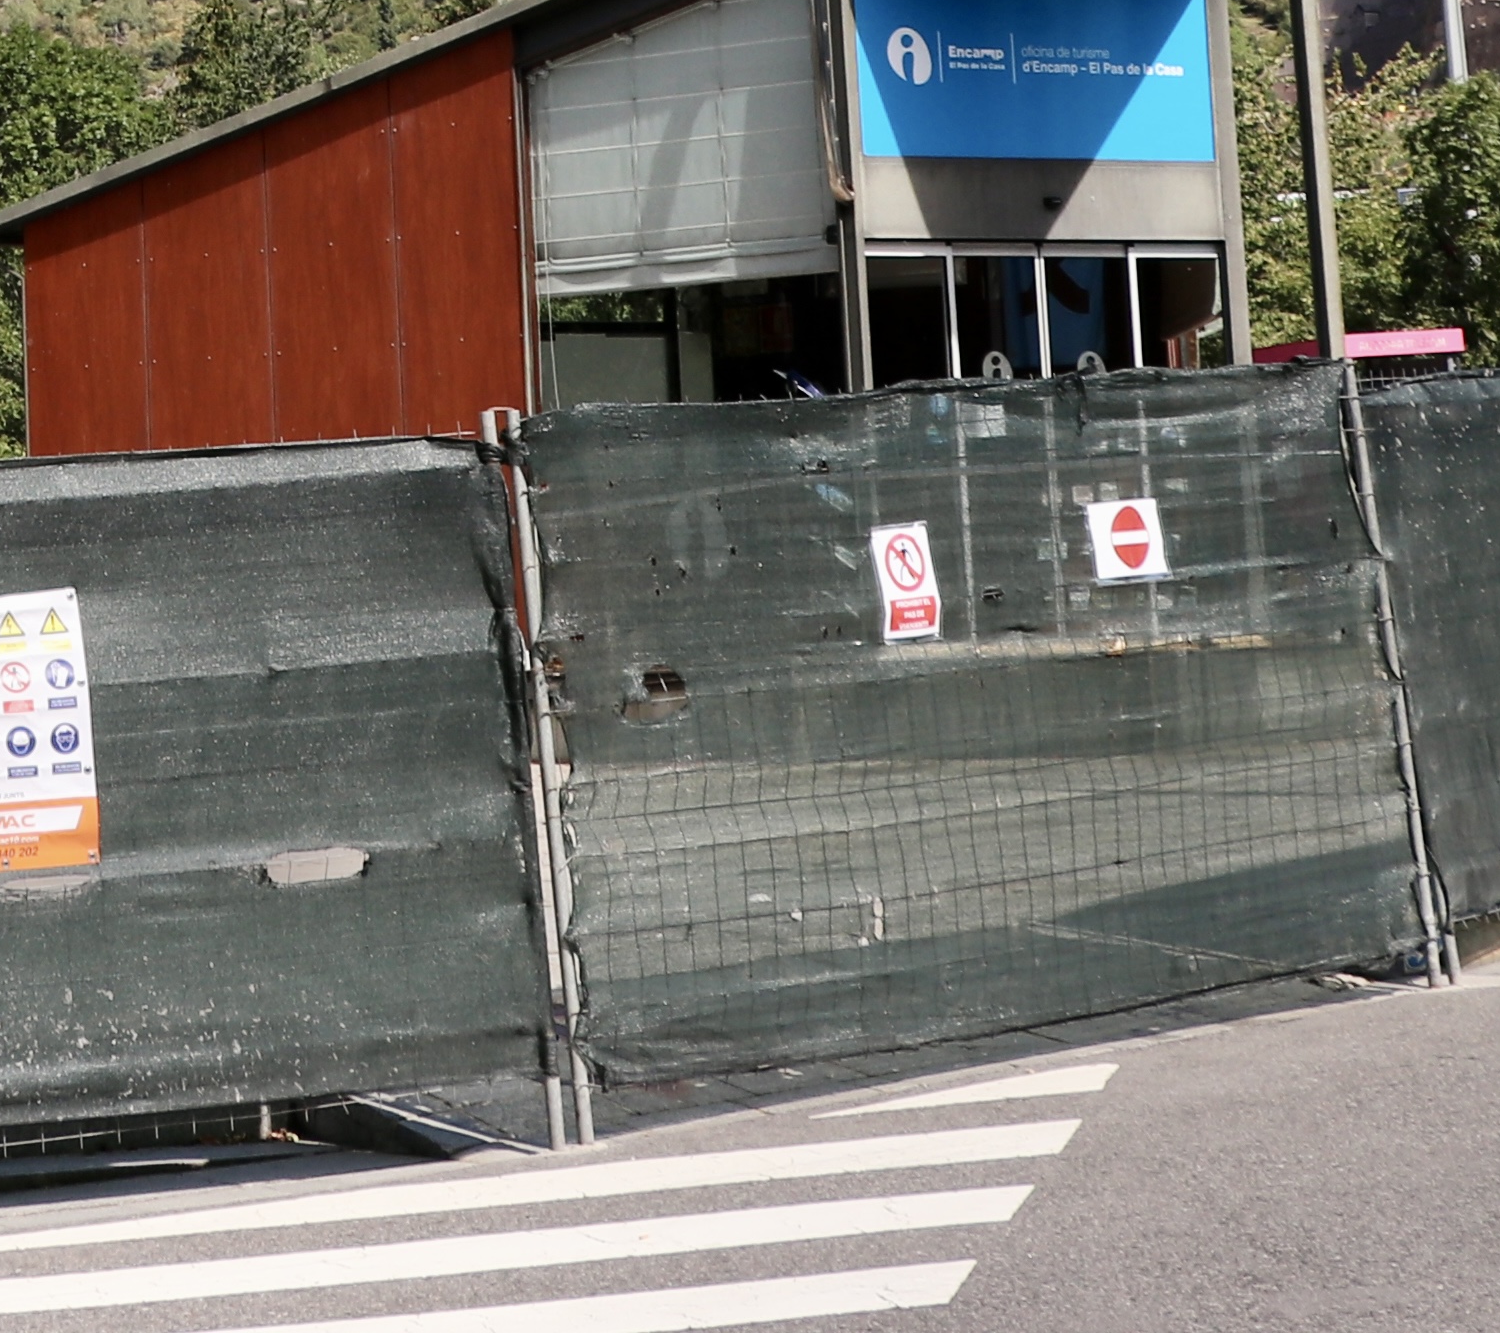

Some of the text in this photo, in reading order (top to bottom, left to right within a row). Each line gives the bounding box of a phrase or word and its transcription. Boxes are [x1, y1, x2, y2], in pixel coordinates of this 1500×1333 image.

[948, 45, 1004, 61] Encamp
[1021, 45, 1110, 59] oficina de turisme
[1022, 60, 1078, 76] d'Encamp
[1089, 62, 1100, 74] El
[1103, 62, 1124, 75] Pas
[1126, 63, 1140, 75] de
[1143, 63, 1153, 76] la
[1155, 62, 1184, 77] Casa
[19, 845, 39, 858] 202
